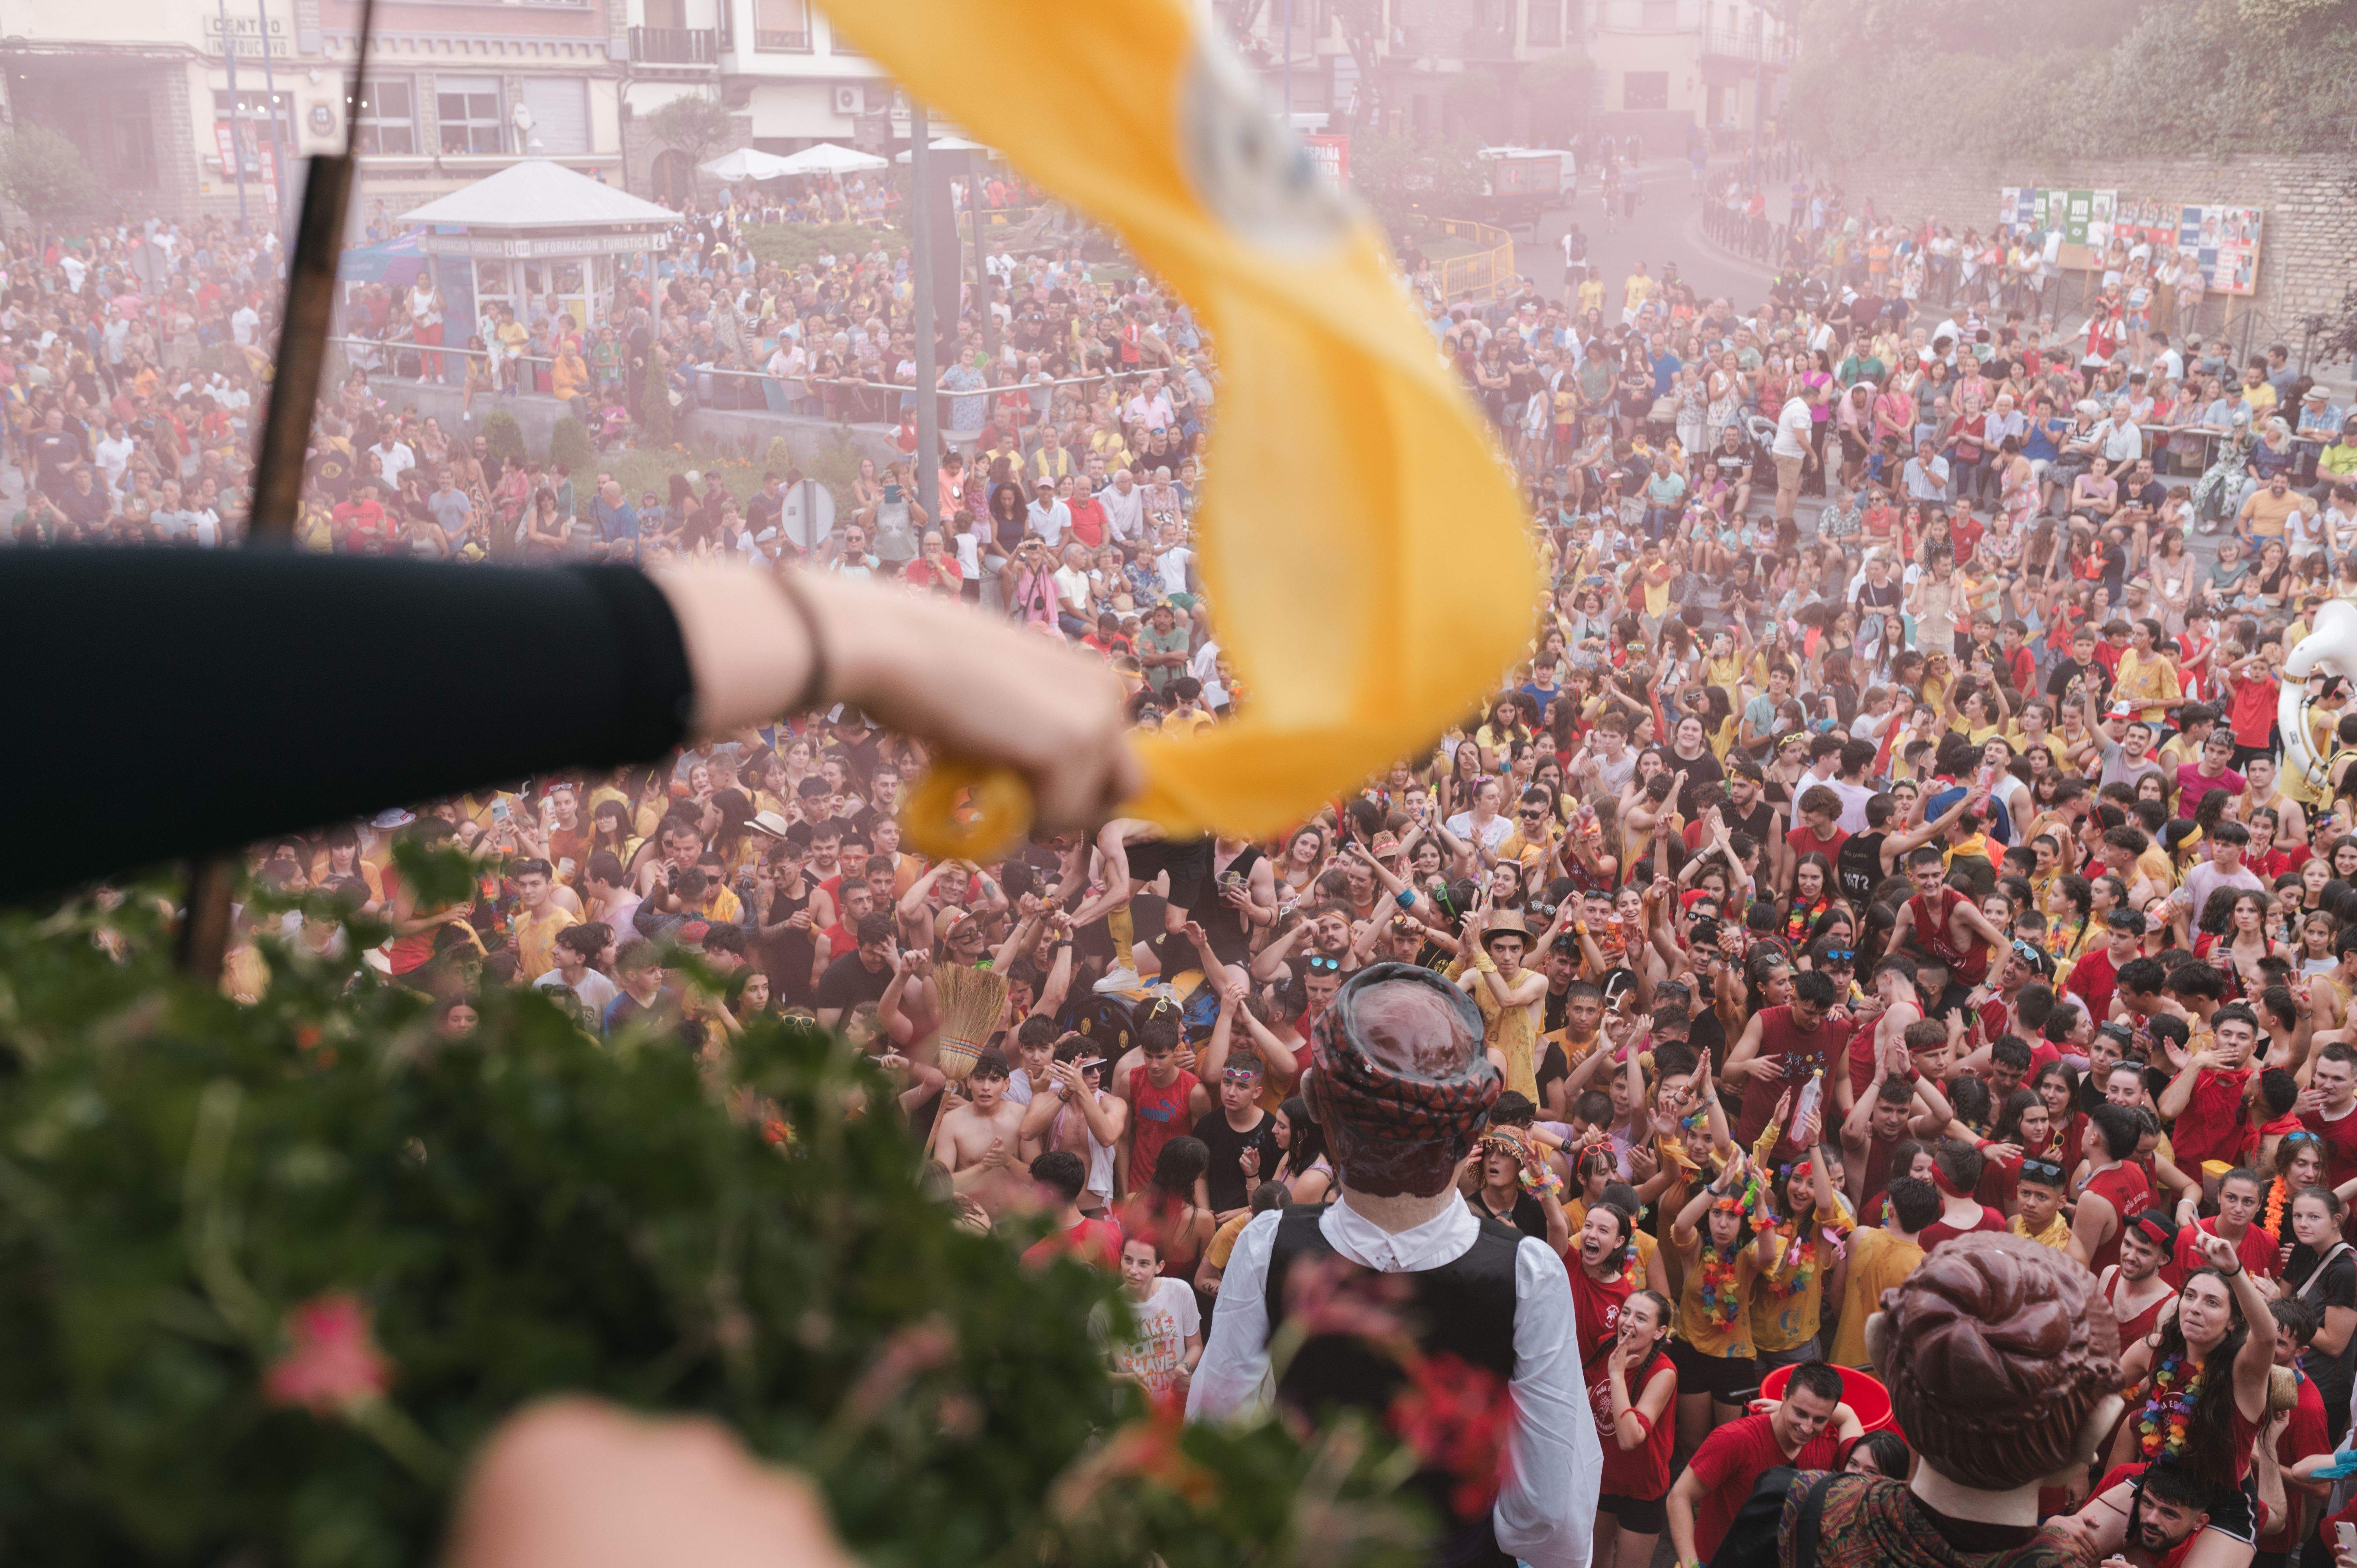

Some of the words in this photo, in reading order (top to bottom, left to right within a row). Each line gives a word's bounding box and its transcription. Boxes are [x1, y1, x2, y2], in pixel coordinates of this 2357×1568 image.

[213, 19, 280, 33] CENTO
[2034, 198, 2046, 213] OTA
[1141, 1106, 1170, 1122] PUMA
[1140, 1315, 1174, 1337] AKE
[1596, 1386, 1606, 1396] PEÑA
